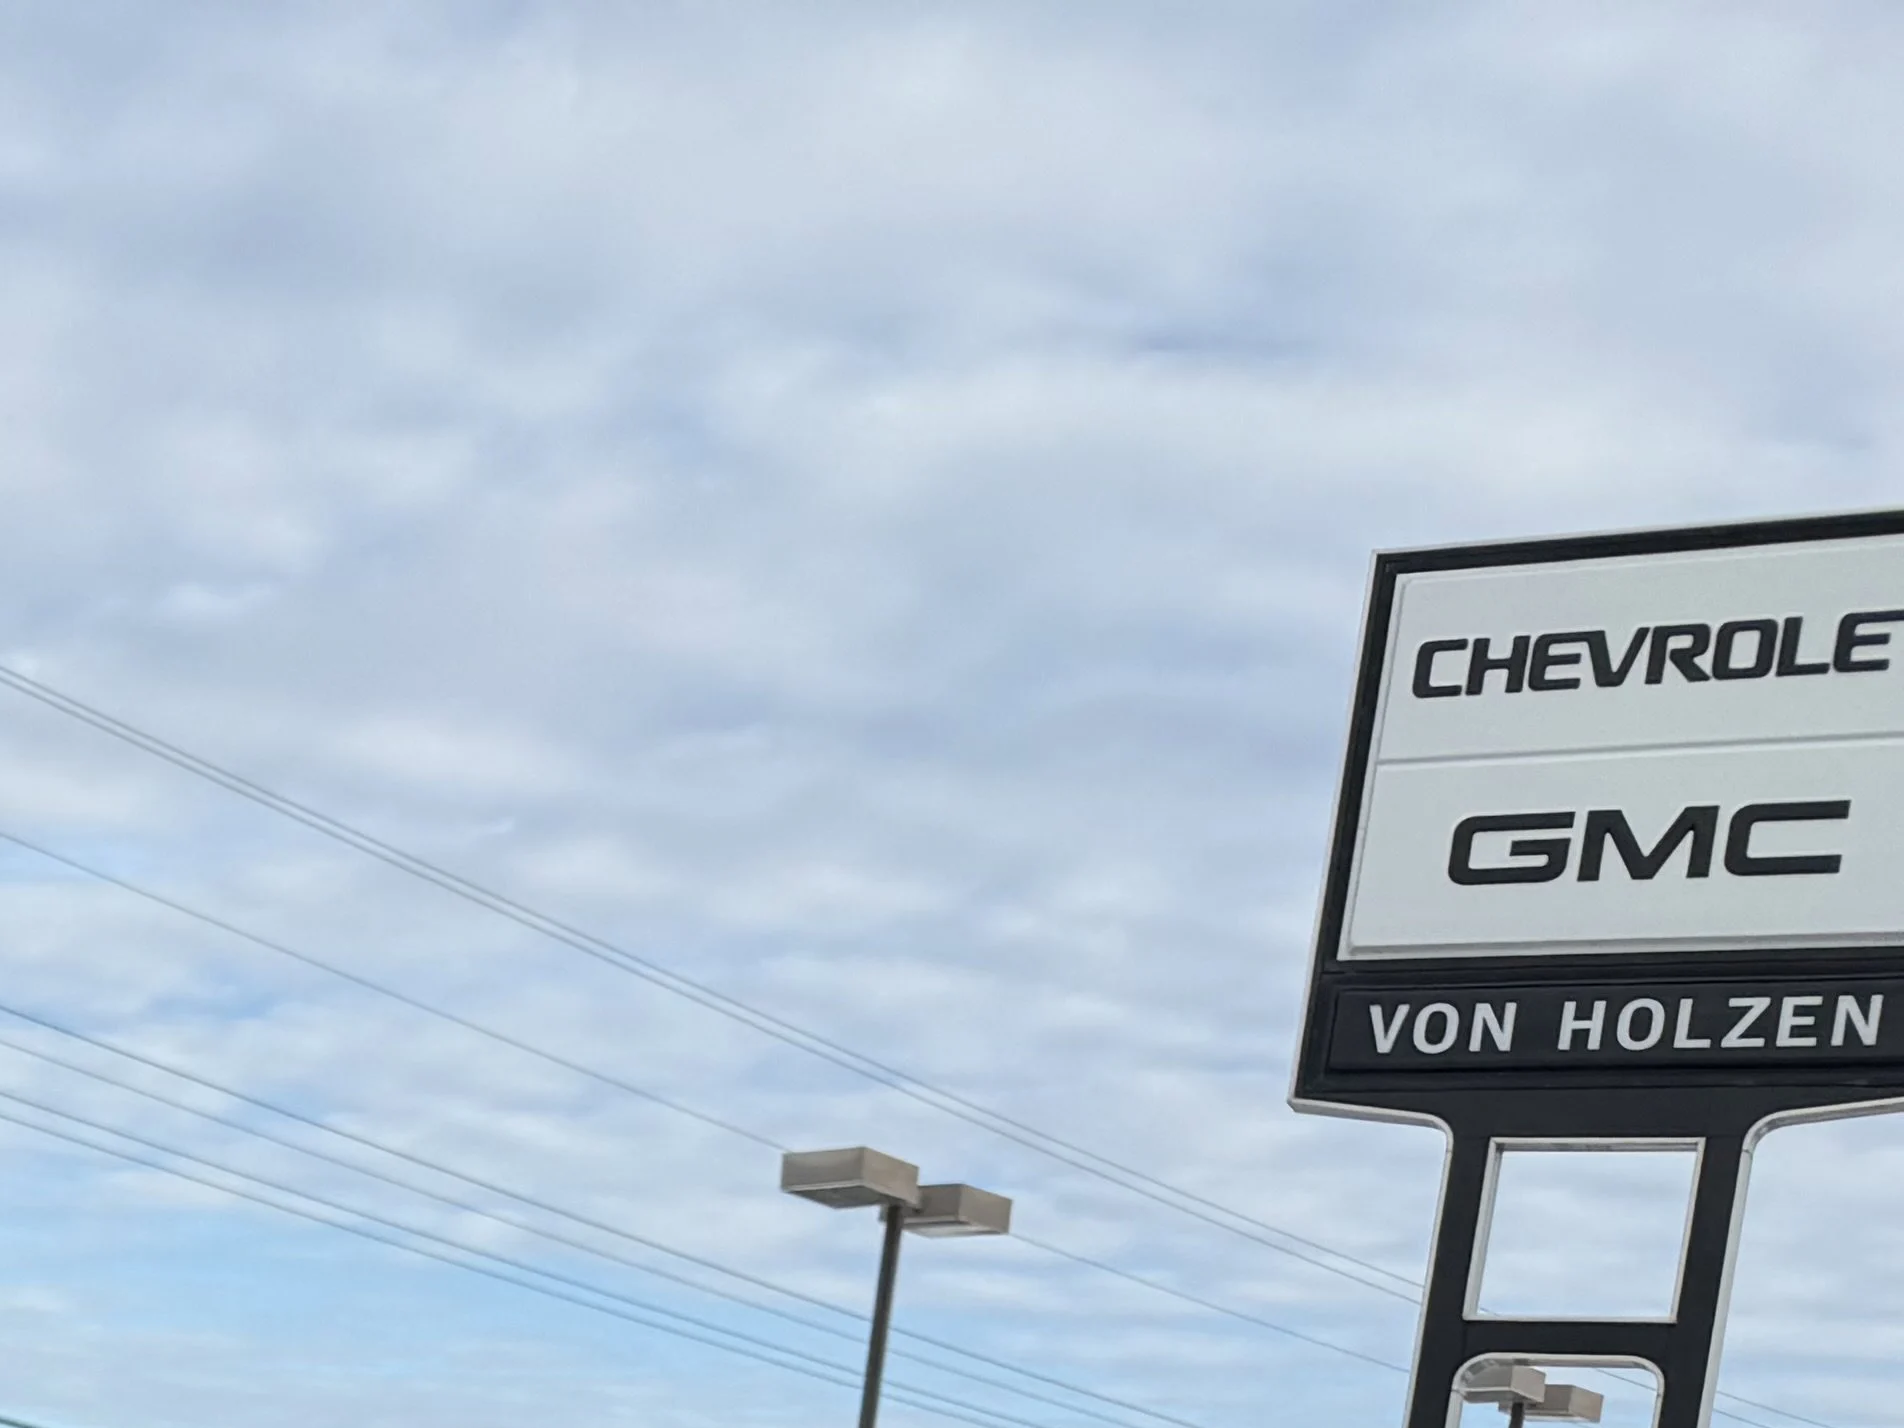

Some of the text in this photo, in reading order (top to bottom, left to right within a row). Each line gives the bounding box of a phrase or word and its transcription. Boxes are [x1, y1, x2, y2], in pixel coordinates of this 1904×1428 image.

[1411, 609, 1904, 698] CHEVROLE
[1447, 799, 1852, 886] GMC
[1368, 994, 1885, 1056] VON HOLZEN
